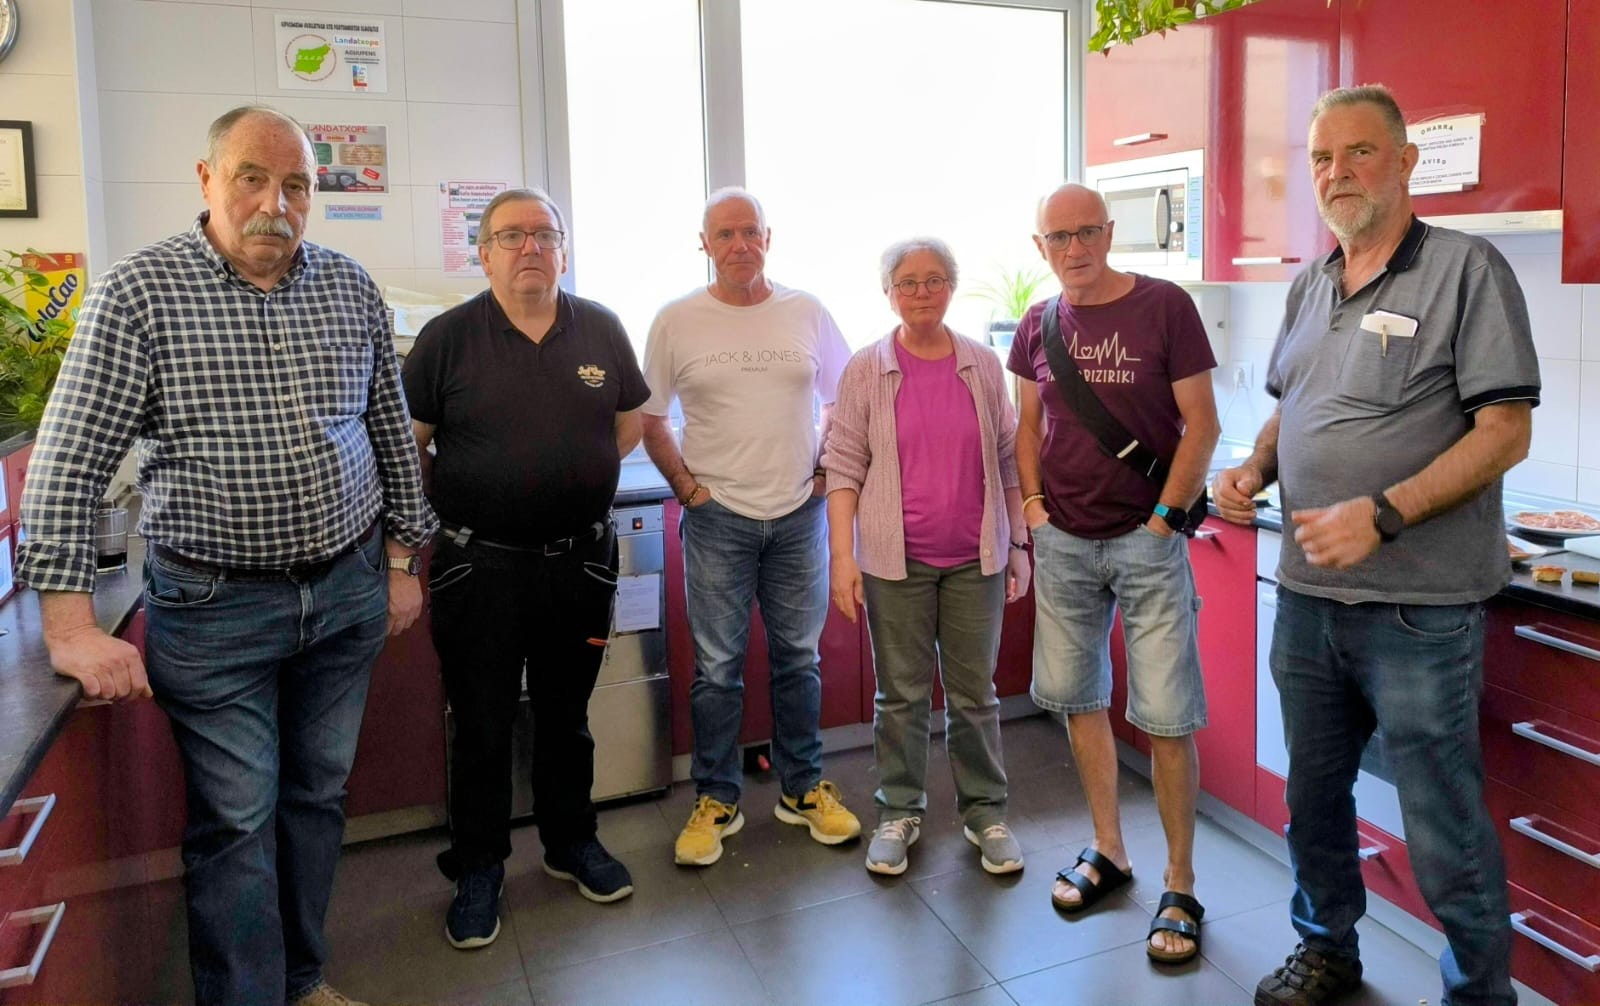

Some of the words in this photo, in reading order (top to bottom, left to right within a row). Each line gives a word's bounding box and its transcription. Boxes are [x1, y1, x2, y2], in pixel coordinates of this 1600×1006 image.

[334, 37, 379, 47] Landatxope
[307, 125, 368, 133] LANDATXOPE
[1421, 124, 1453, 135] OHARRA
[705, 351, 739, 367] JACK
[742, 350, 753, 363] &
[757, 350, 800, 362] JONES
